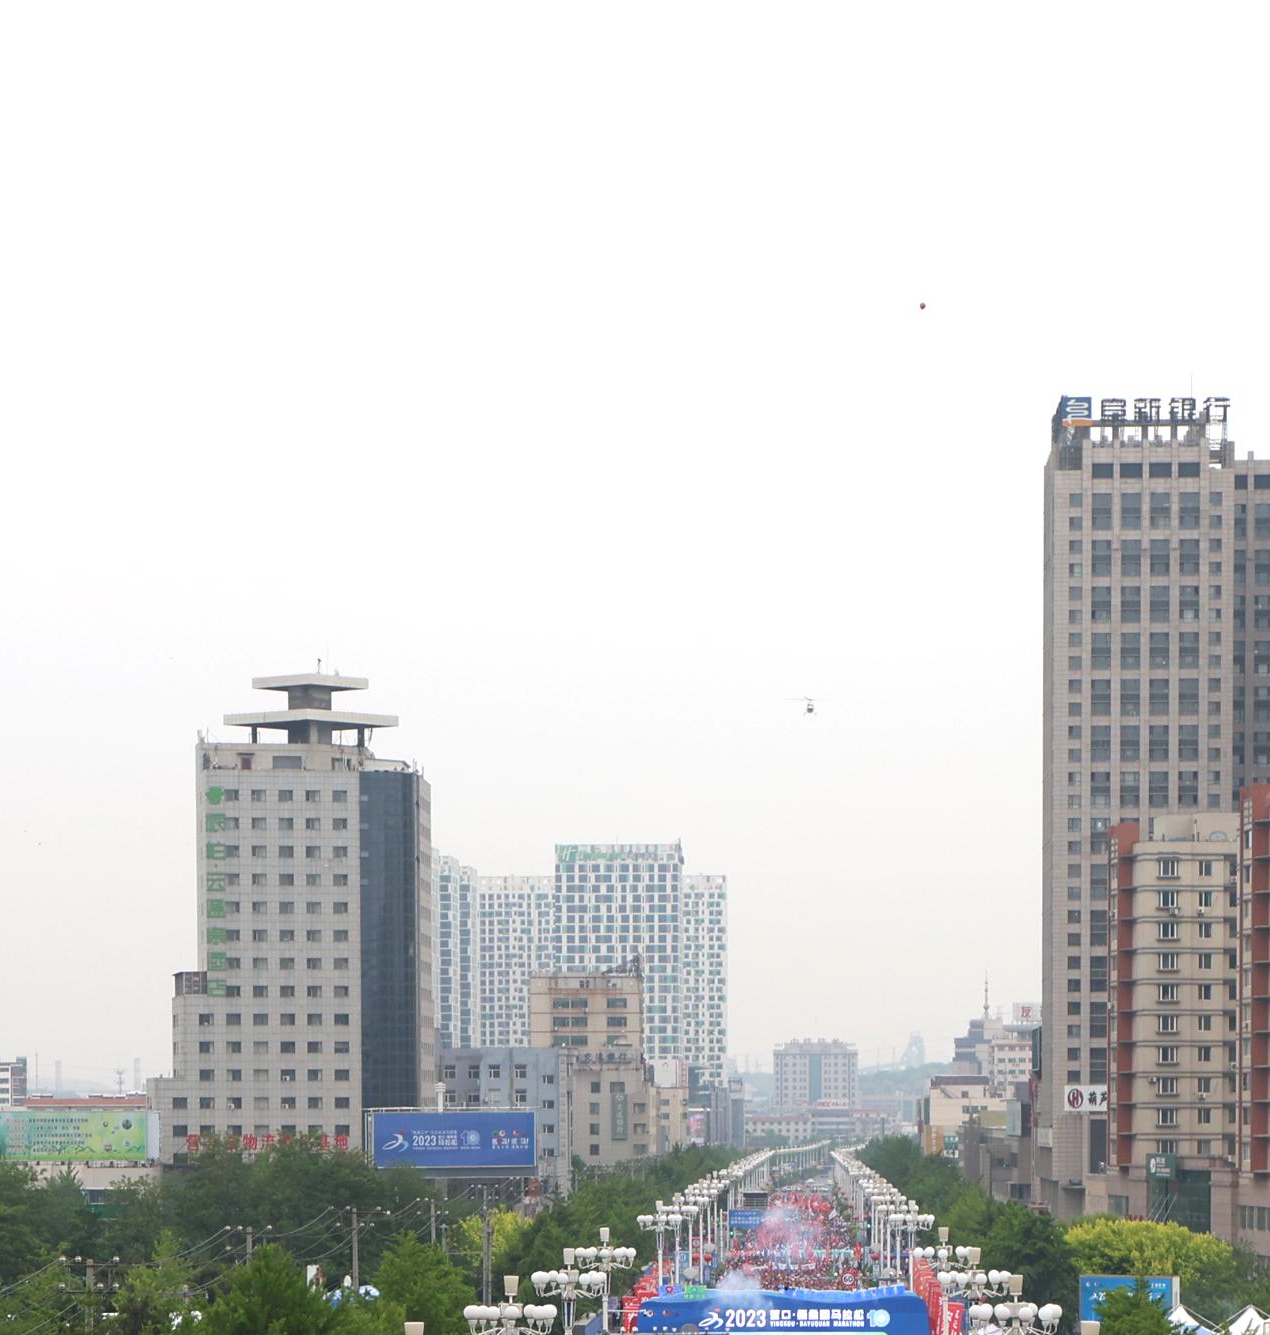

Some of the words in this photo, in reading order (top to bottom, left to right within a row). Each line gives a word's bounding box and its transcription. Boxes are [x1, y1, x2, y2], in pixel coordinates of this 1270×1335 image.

[413, 1135, 437, 1146] 2023
[844, 1275, 853, 1283] 60
[725, 1309, 767, 1327] 2023
